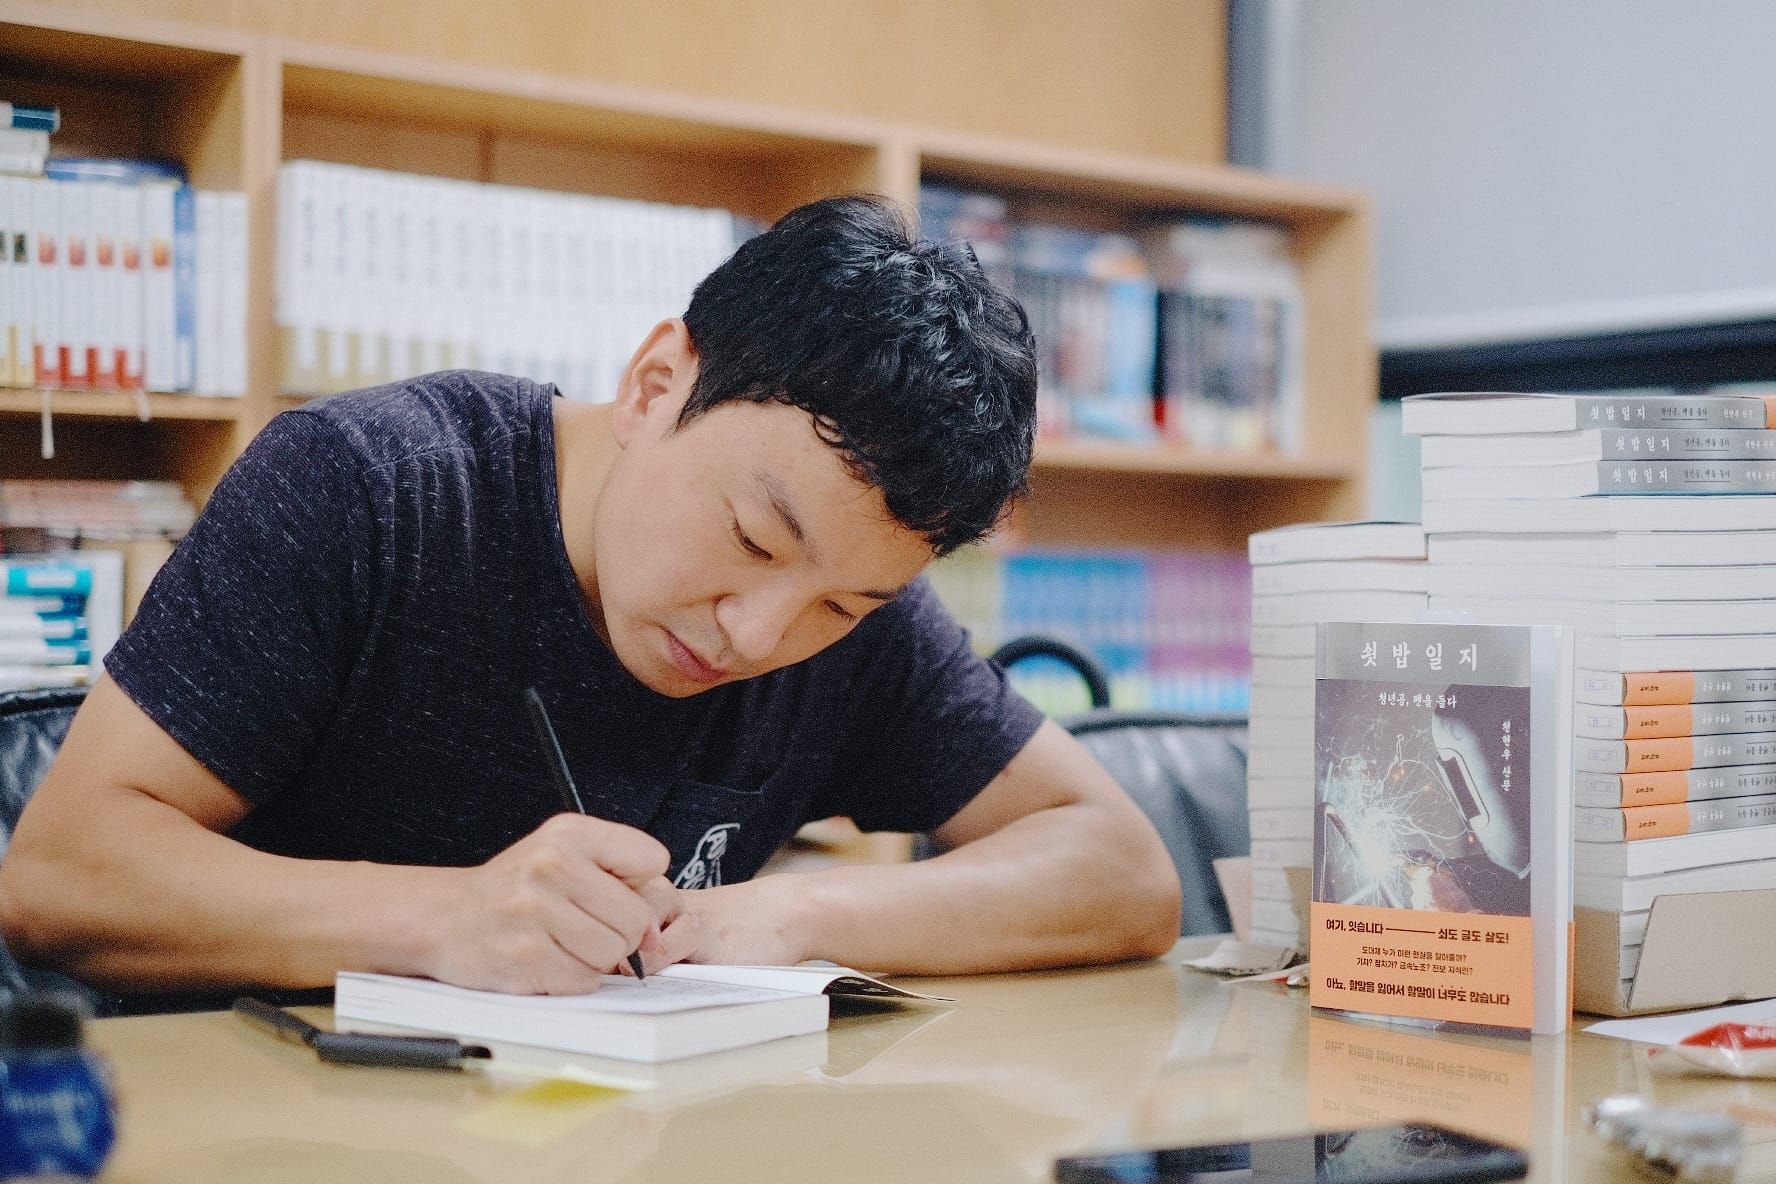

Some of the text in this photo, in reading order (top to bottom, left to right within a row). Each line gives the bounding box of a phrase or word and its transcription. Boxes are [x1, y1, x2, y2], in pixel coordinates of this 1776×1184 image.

[1360, 640, 1478, 671] 쇳밥일지
[1378, 692, 1457, 709] 청년공, 펜을 들다
[1326, 919, 1509, 944] 여기, 잇습니다 쇠도 글도 삶도!
[1362, 946, 1381, 956] 도대체
[1382, 948, 1396, 957] 누가
[1397, 949, 1411, 959] 이런
[1412, 950, 1433, 960] 현실을
[1356, 957, 1473, 976] 기자? 정치가? 금속노조? 진보 지식인?
[1326, 977, 1510, 1005] 아뇨, 할말을 잃어서 할말이 너무도 많습니다
